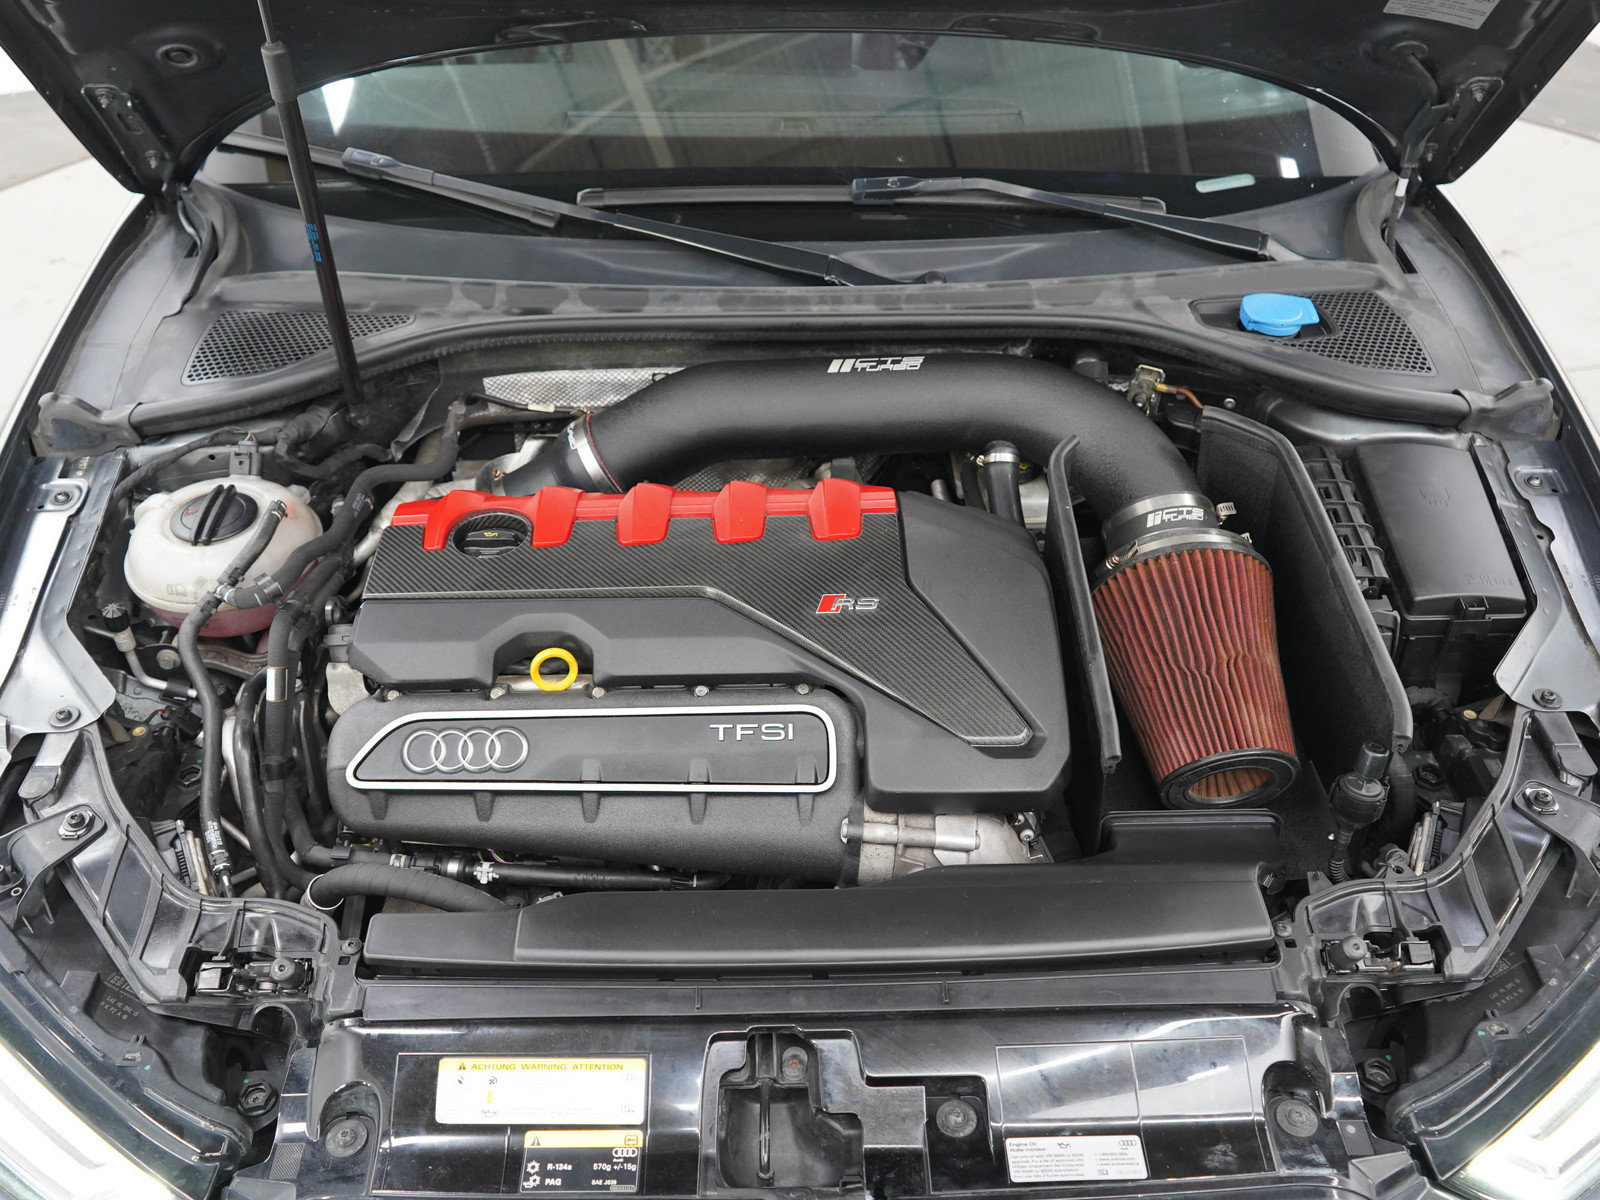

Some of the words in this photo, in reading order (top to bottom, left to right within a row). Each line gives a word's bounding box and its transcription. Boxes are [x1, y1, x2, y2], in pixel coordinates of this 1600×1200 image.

[855, 356, 925, 365] CTS
[854, 363, 921, 372] TURBO
[1163, 507, 1204, 516] CTS
[830, 597, 880, 611] RS
[709, 723, 794, 741] TFSI
[547, 1163, 573, 1171] R-134a
[593, 1163, 612, 1172] 570g
[613, 1163, 637, 1172] +/-15g
[545, 1178, 562, 1186] PAG
